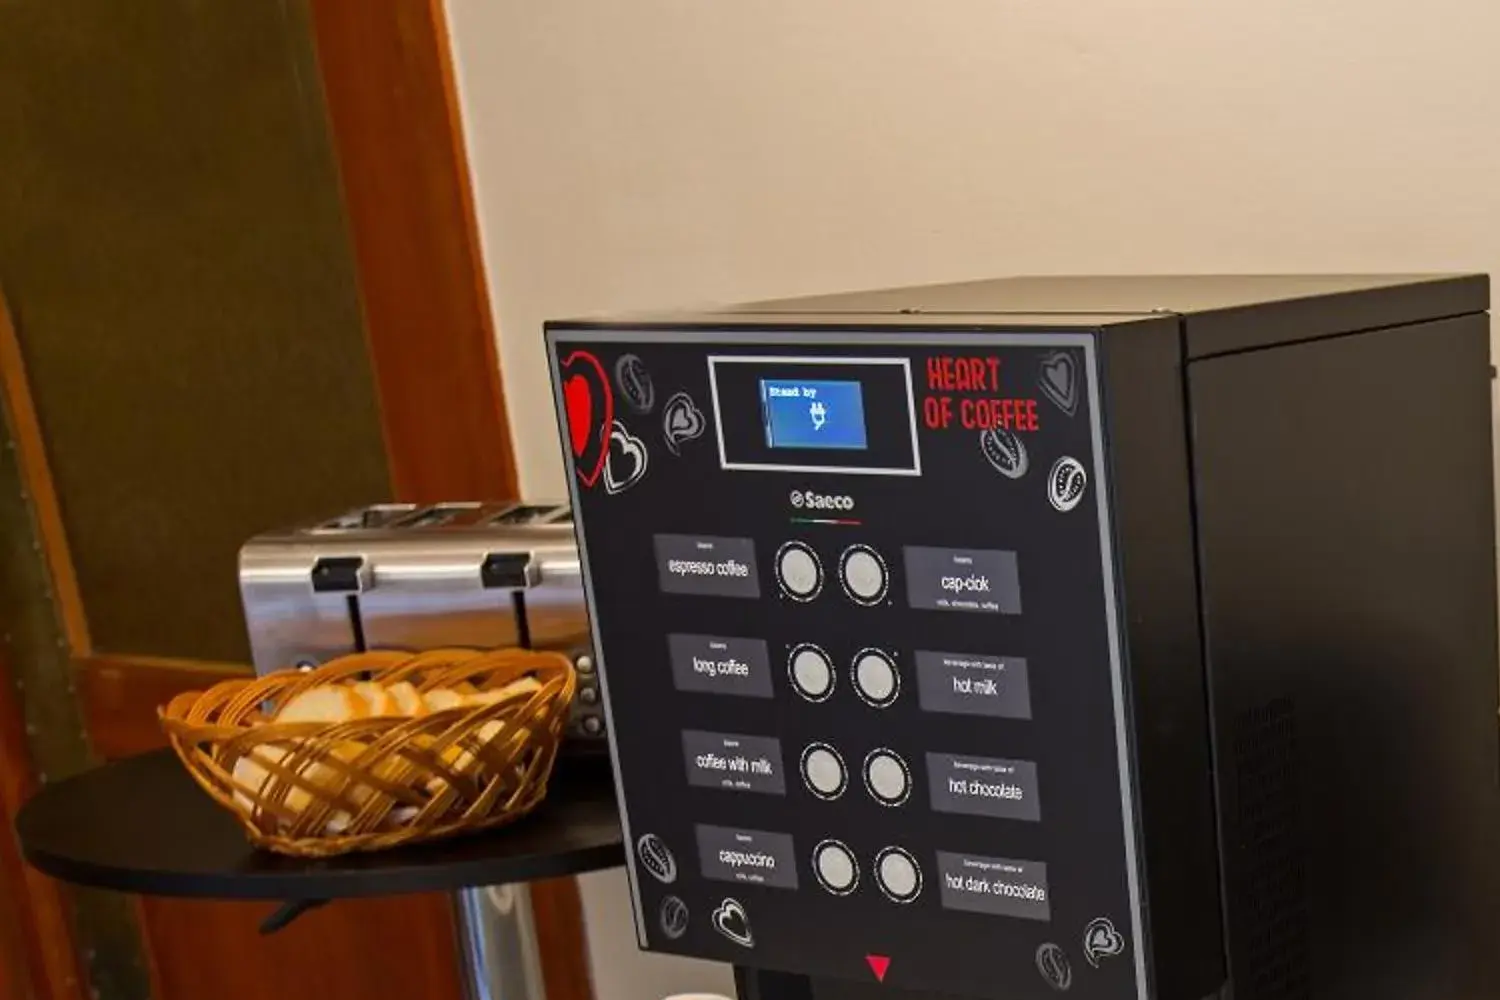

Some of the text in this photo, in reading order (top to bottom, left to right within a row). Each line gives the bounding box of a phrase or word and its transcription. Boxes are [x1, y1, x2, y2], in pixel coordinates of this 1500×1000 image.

[926, 356, 1000, 392] HEART
[801, 386, 818, 400] by
[924, 396, 1039, 432] OF COFFEE
[805, 490, 855, 511] Saeco
[668, 559, 749, 578] espresso coffee
[693, 656, 749, 678] long coffee
[953, 676, 998, 696] hot milk
[695, 753, 773, 776] coffee with milk
[947, 776, 1023, 801] hot chocolate
[719, 850, 776, 869] cappuccino
[945, 872, 1045, 902] hot dark chocolate
